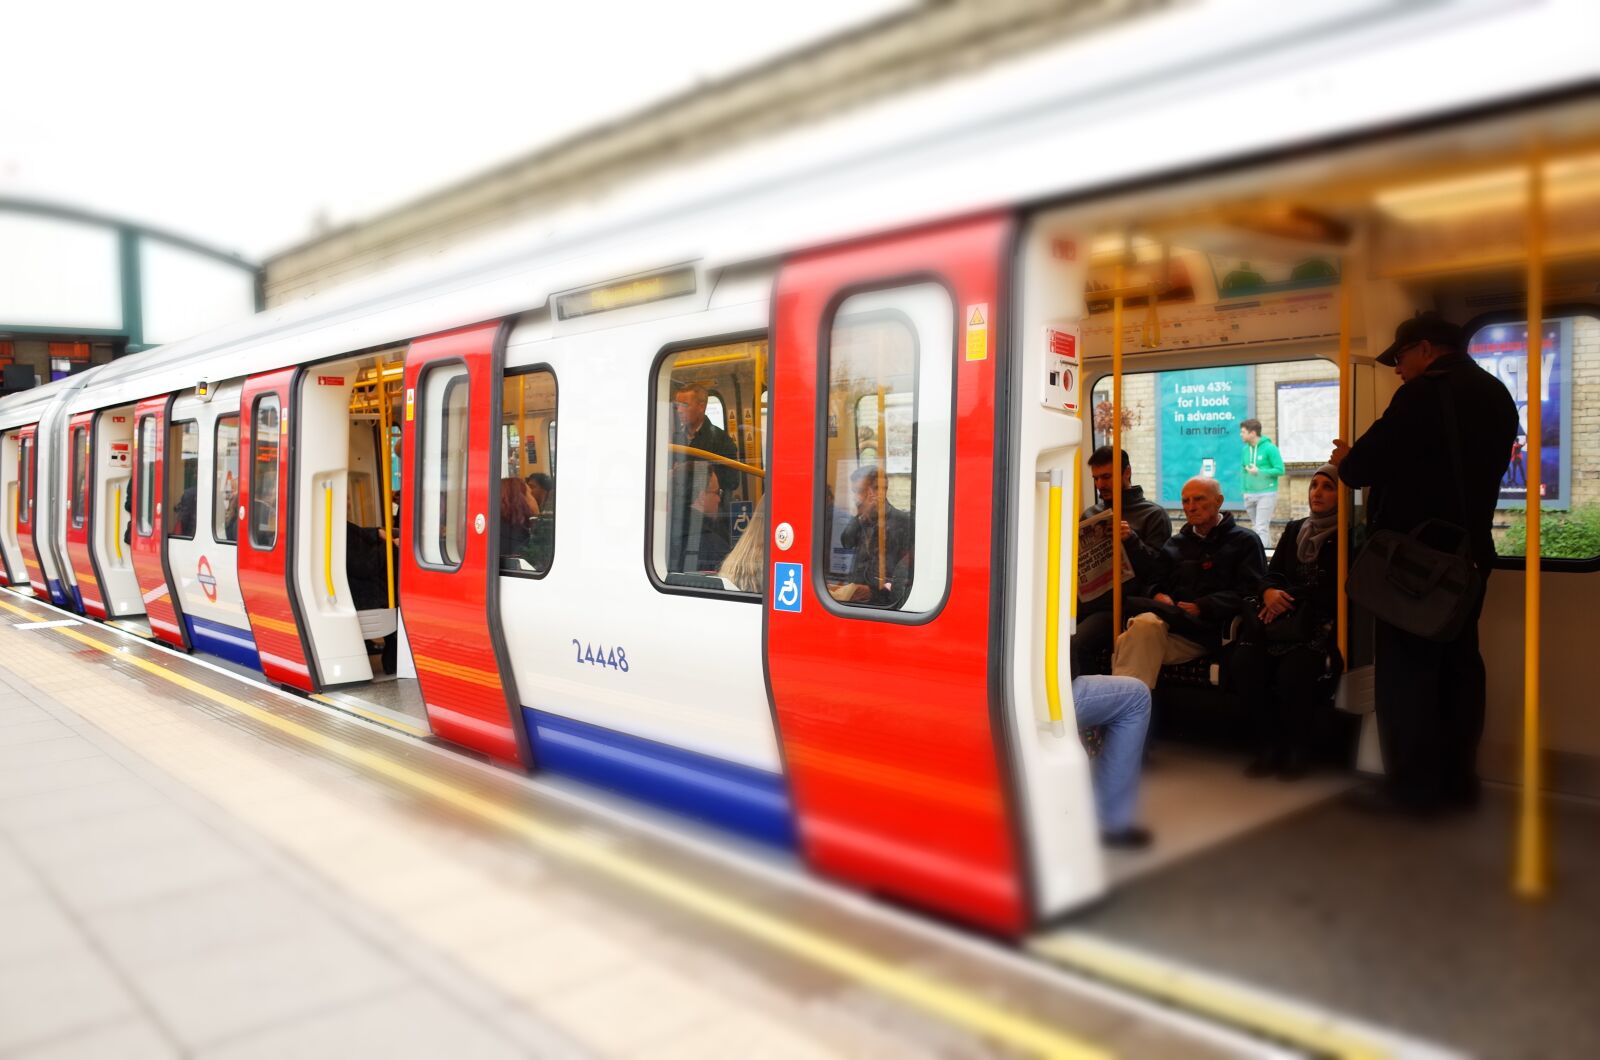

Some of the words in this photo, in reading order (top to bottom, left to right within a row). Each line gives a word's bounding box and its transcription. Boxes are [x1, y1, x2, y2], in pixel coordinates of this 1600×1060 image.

[1175, 383, 1179, 394] I
[1181, 385, 1205, 394] save
[1177, 396, 1194, 408] for
[1196, 396, 1199, 407] I
[1201, 394, 1230, 407] book
[1174, 411, 1185, 422] in
[1187, 411, 1235, 421] advance.
[1180, 426, 1184, 436] I
[1185, 428, 1201, 436] am
[1204, 426, 1229, 435] train.
[572, 638, 629, 673] 24448
